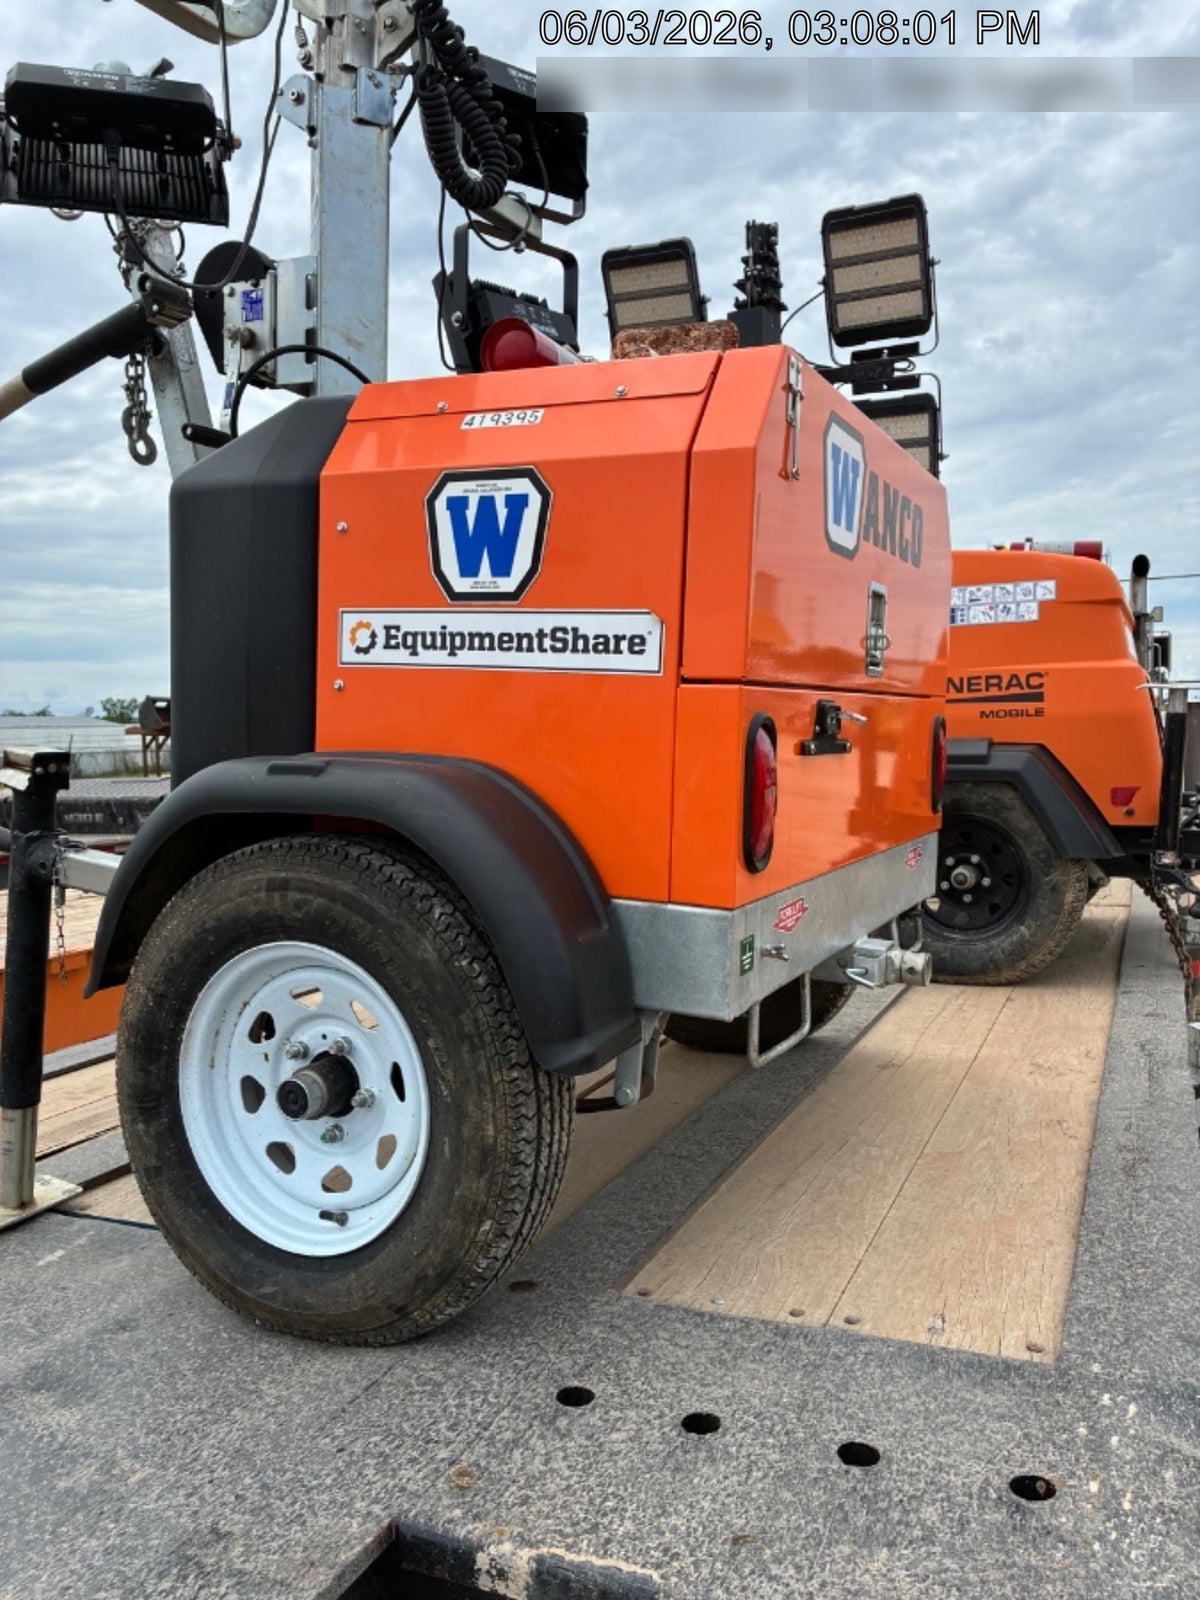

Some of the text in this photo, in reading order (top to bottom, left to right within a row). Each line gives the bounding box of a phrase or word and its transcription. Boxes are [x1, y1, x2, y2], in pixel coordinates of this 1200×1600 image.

[464, 410, 540, 427] 419395
[446, 494, 528, 578] W
[383, 625, 646, 656] EquipmentShare
[980, 707, 1045, 719] MOBILE
